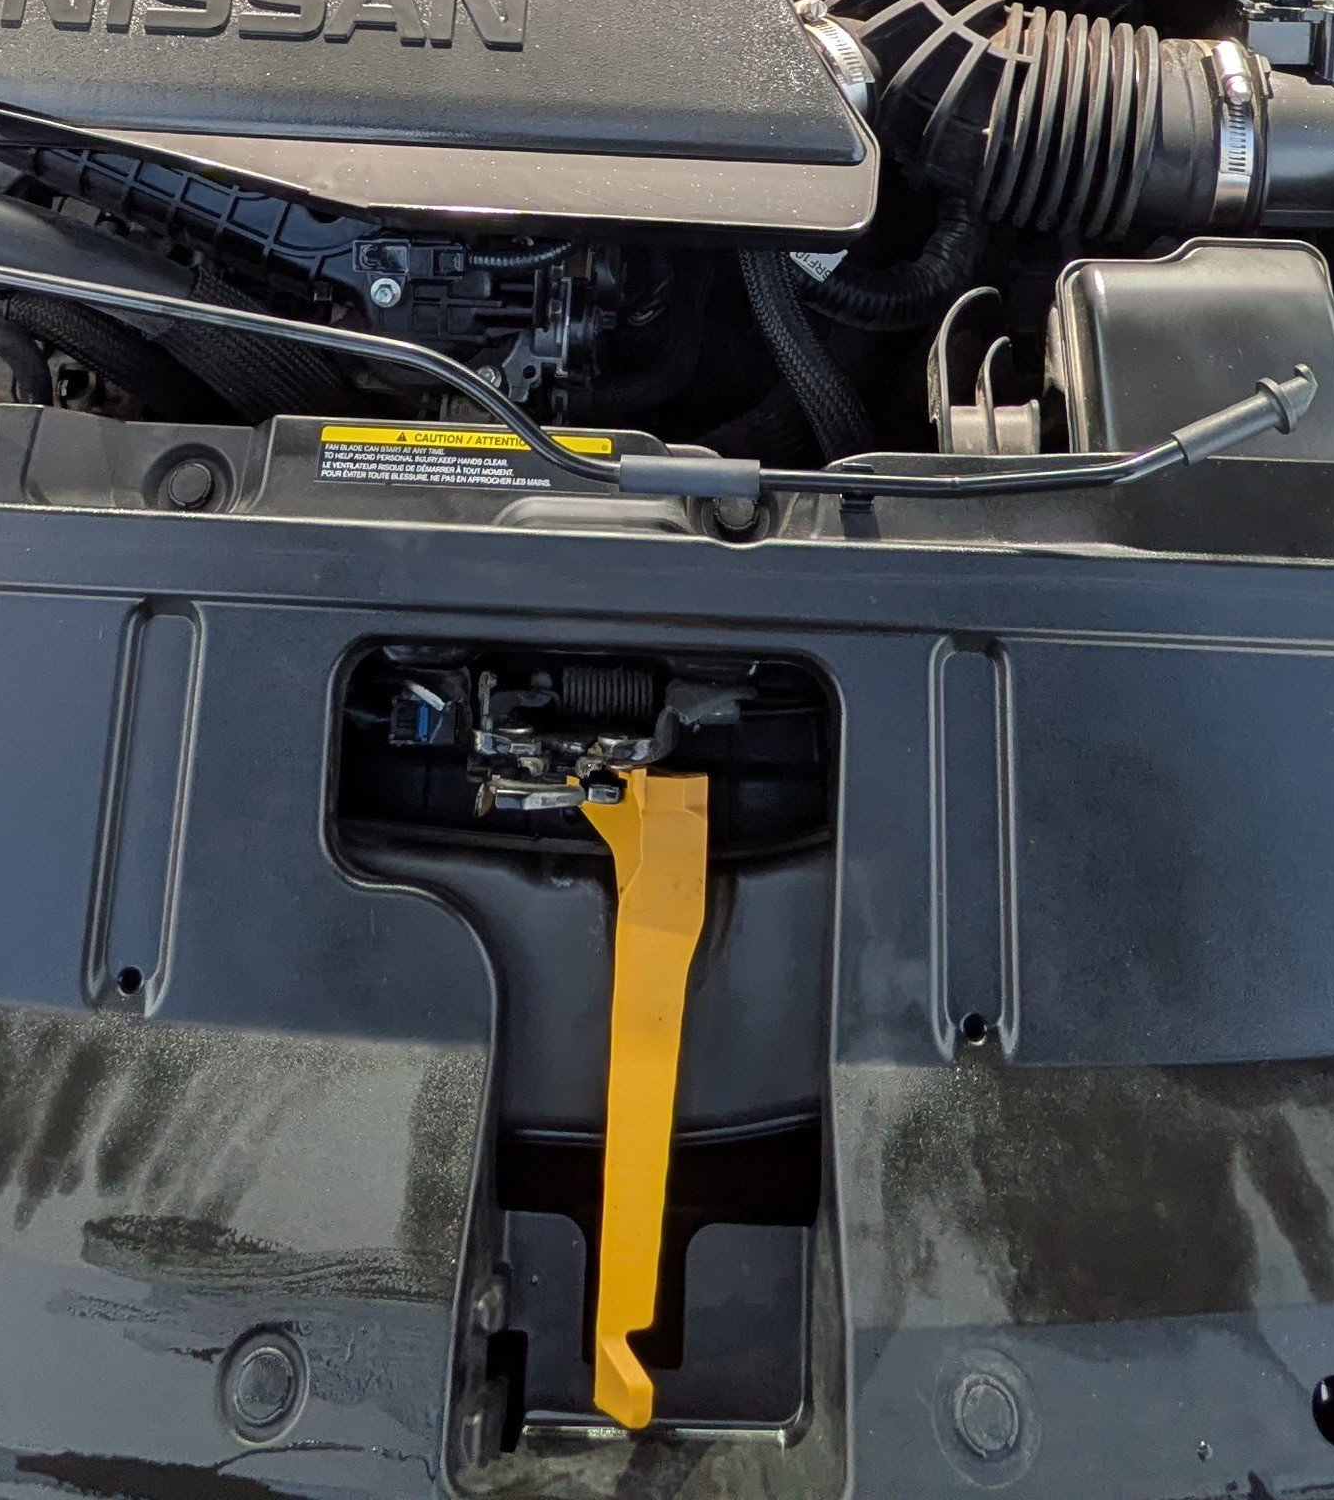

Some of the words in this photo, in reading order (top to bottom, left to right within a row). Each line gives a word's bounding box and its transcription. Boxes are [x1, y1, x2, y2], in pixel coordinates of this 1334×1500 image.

[414, 433, 464, 444] CAUTION
[466, 434, 473, 445] /
[474, 435, 528, 448] ATTENTIO
[340, 444, 363, 452] BLADE
[335, 452, 352, 460] HELP
[354, 453, 375, 461] AVOID
[376, 454, 413, 463] PERSONAL
[457, 457, 482, 466] HANDS
[483, 458, 509, 466] CLEAR.
[322, 461, 331, 469] LE
[332, 461, 377, 470] VENTILATEUR
[405, 464, 416, 472] DE
[462, 467, 481, 475] TOUT
[321, 470, 342, 478] POUR
[367, 471, 390, 480] TOUTE
[430, 474, 440, 482] NE
[440, 474, 456, 483] PAS
[456, 475, 466, 483] EN
[467, 476, 512, 485] APPROCHER
[512, 478, 526, 486] LES
